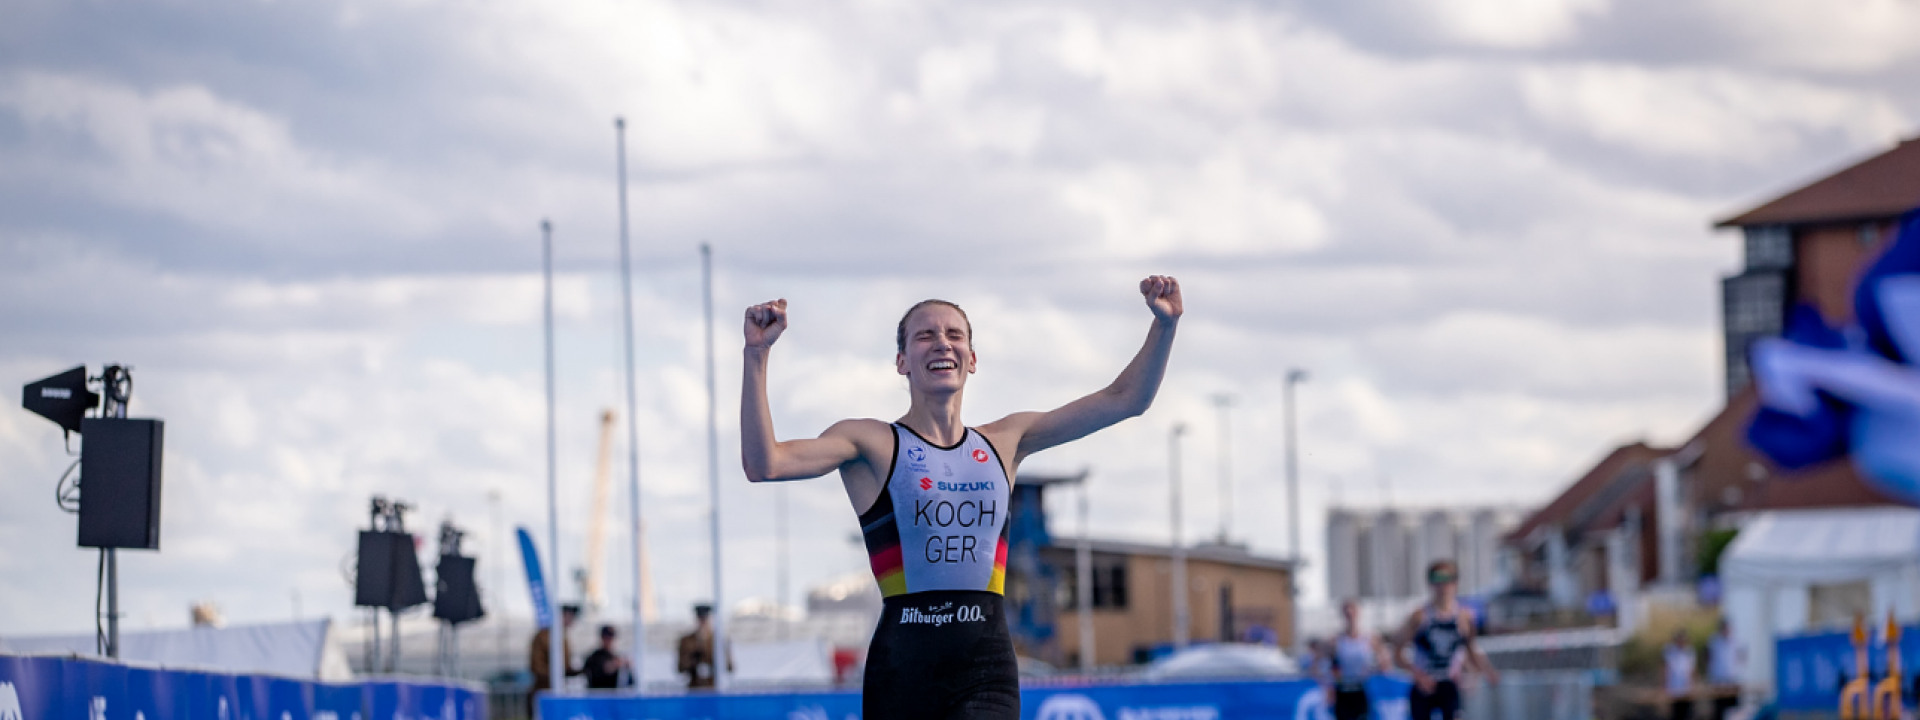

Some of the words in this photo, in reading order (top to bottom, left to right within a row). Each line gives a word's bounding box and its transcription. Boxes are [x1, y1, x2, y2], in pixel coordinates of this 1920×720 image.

[937, 481, 995, 492] SUZUKI
[914, 499, 997, 527] KOCH
[925, 535, 977, 564] GER
[900, 607, 954, 627] Bitburger
